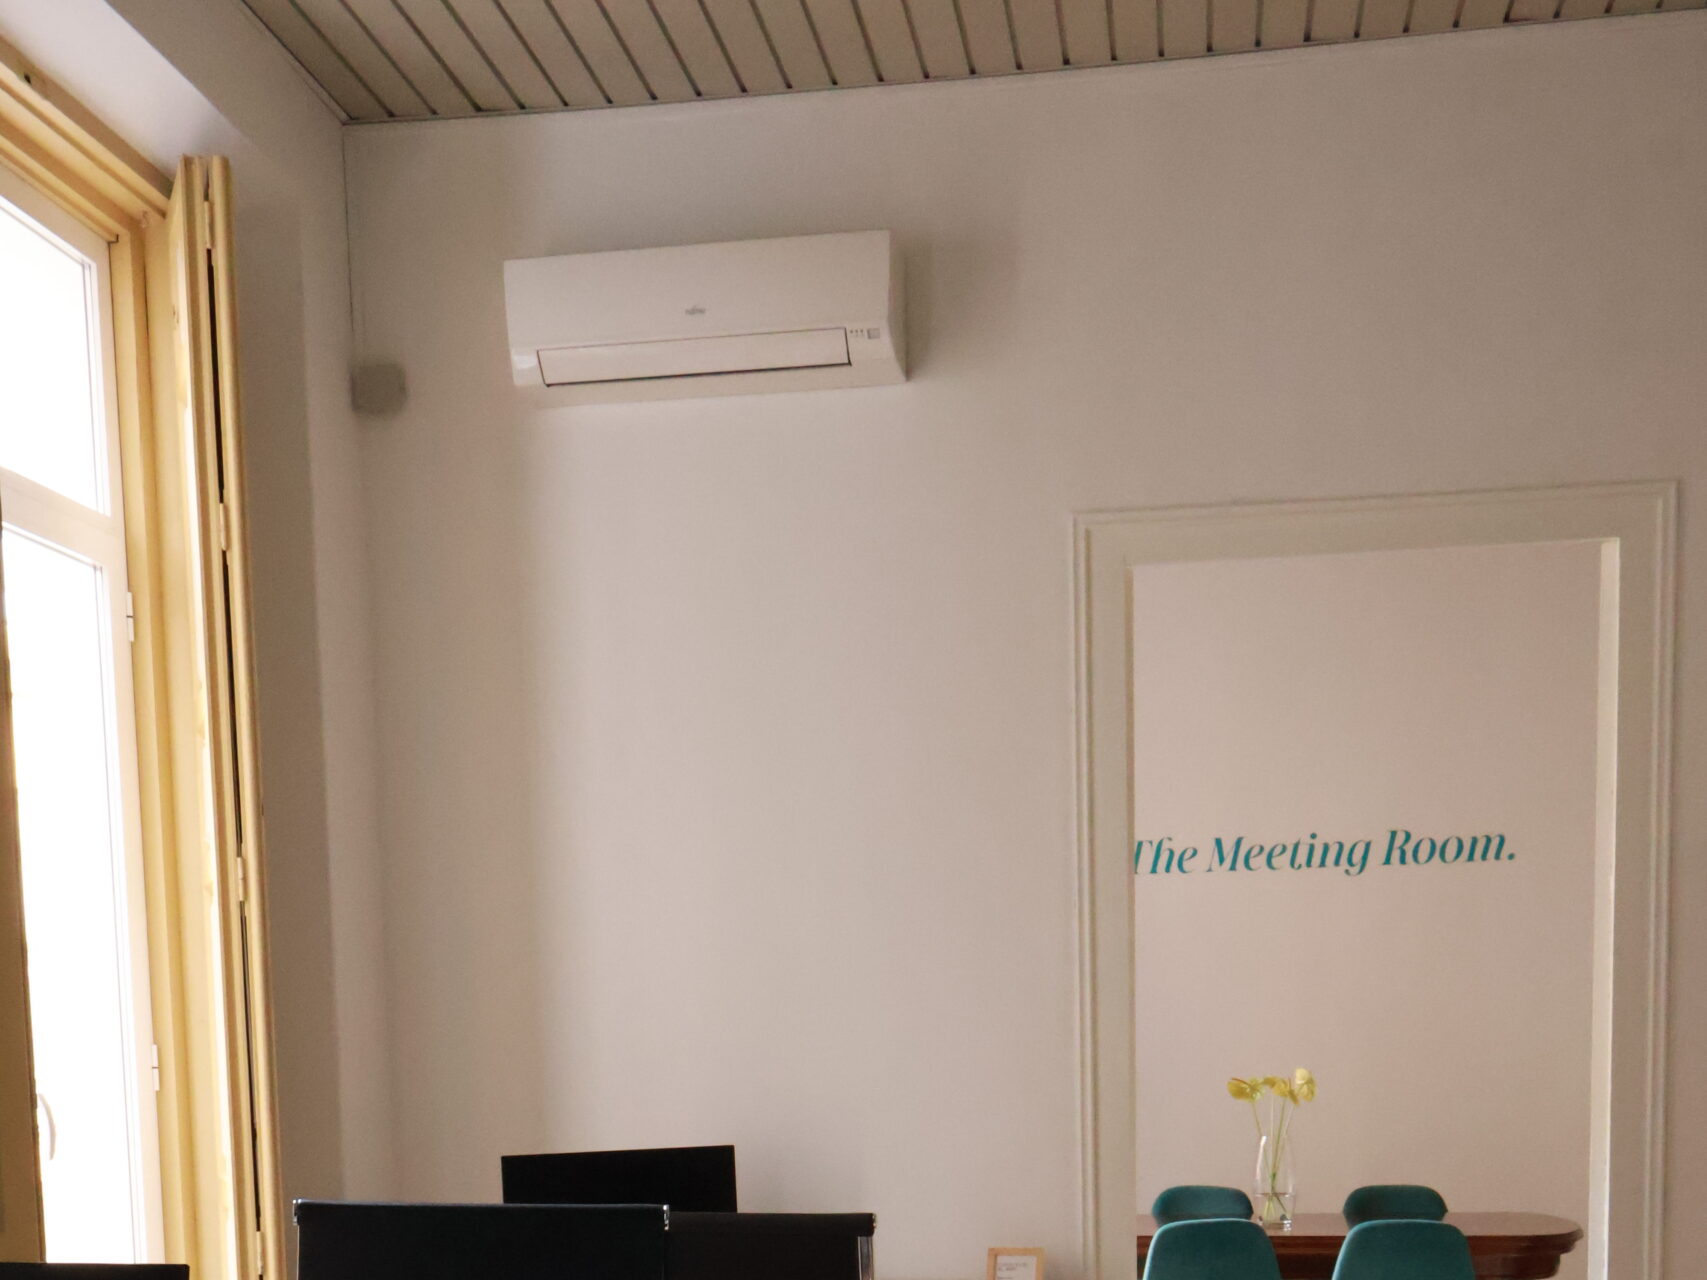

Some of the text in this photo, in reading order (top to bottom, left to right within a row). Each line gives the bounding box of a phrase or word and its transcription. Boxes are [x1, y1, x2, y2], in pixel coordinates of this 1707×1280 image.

[1134, 829, 1517, 877] The Meeting Room.
